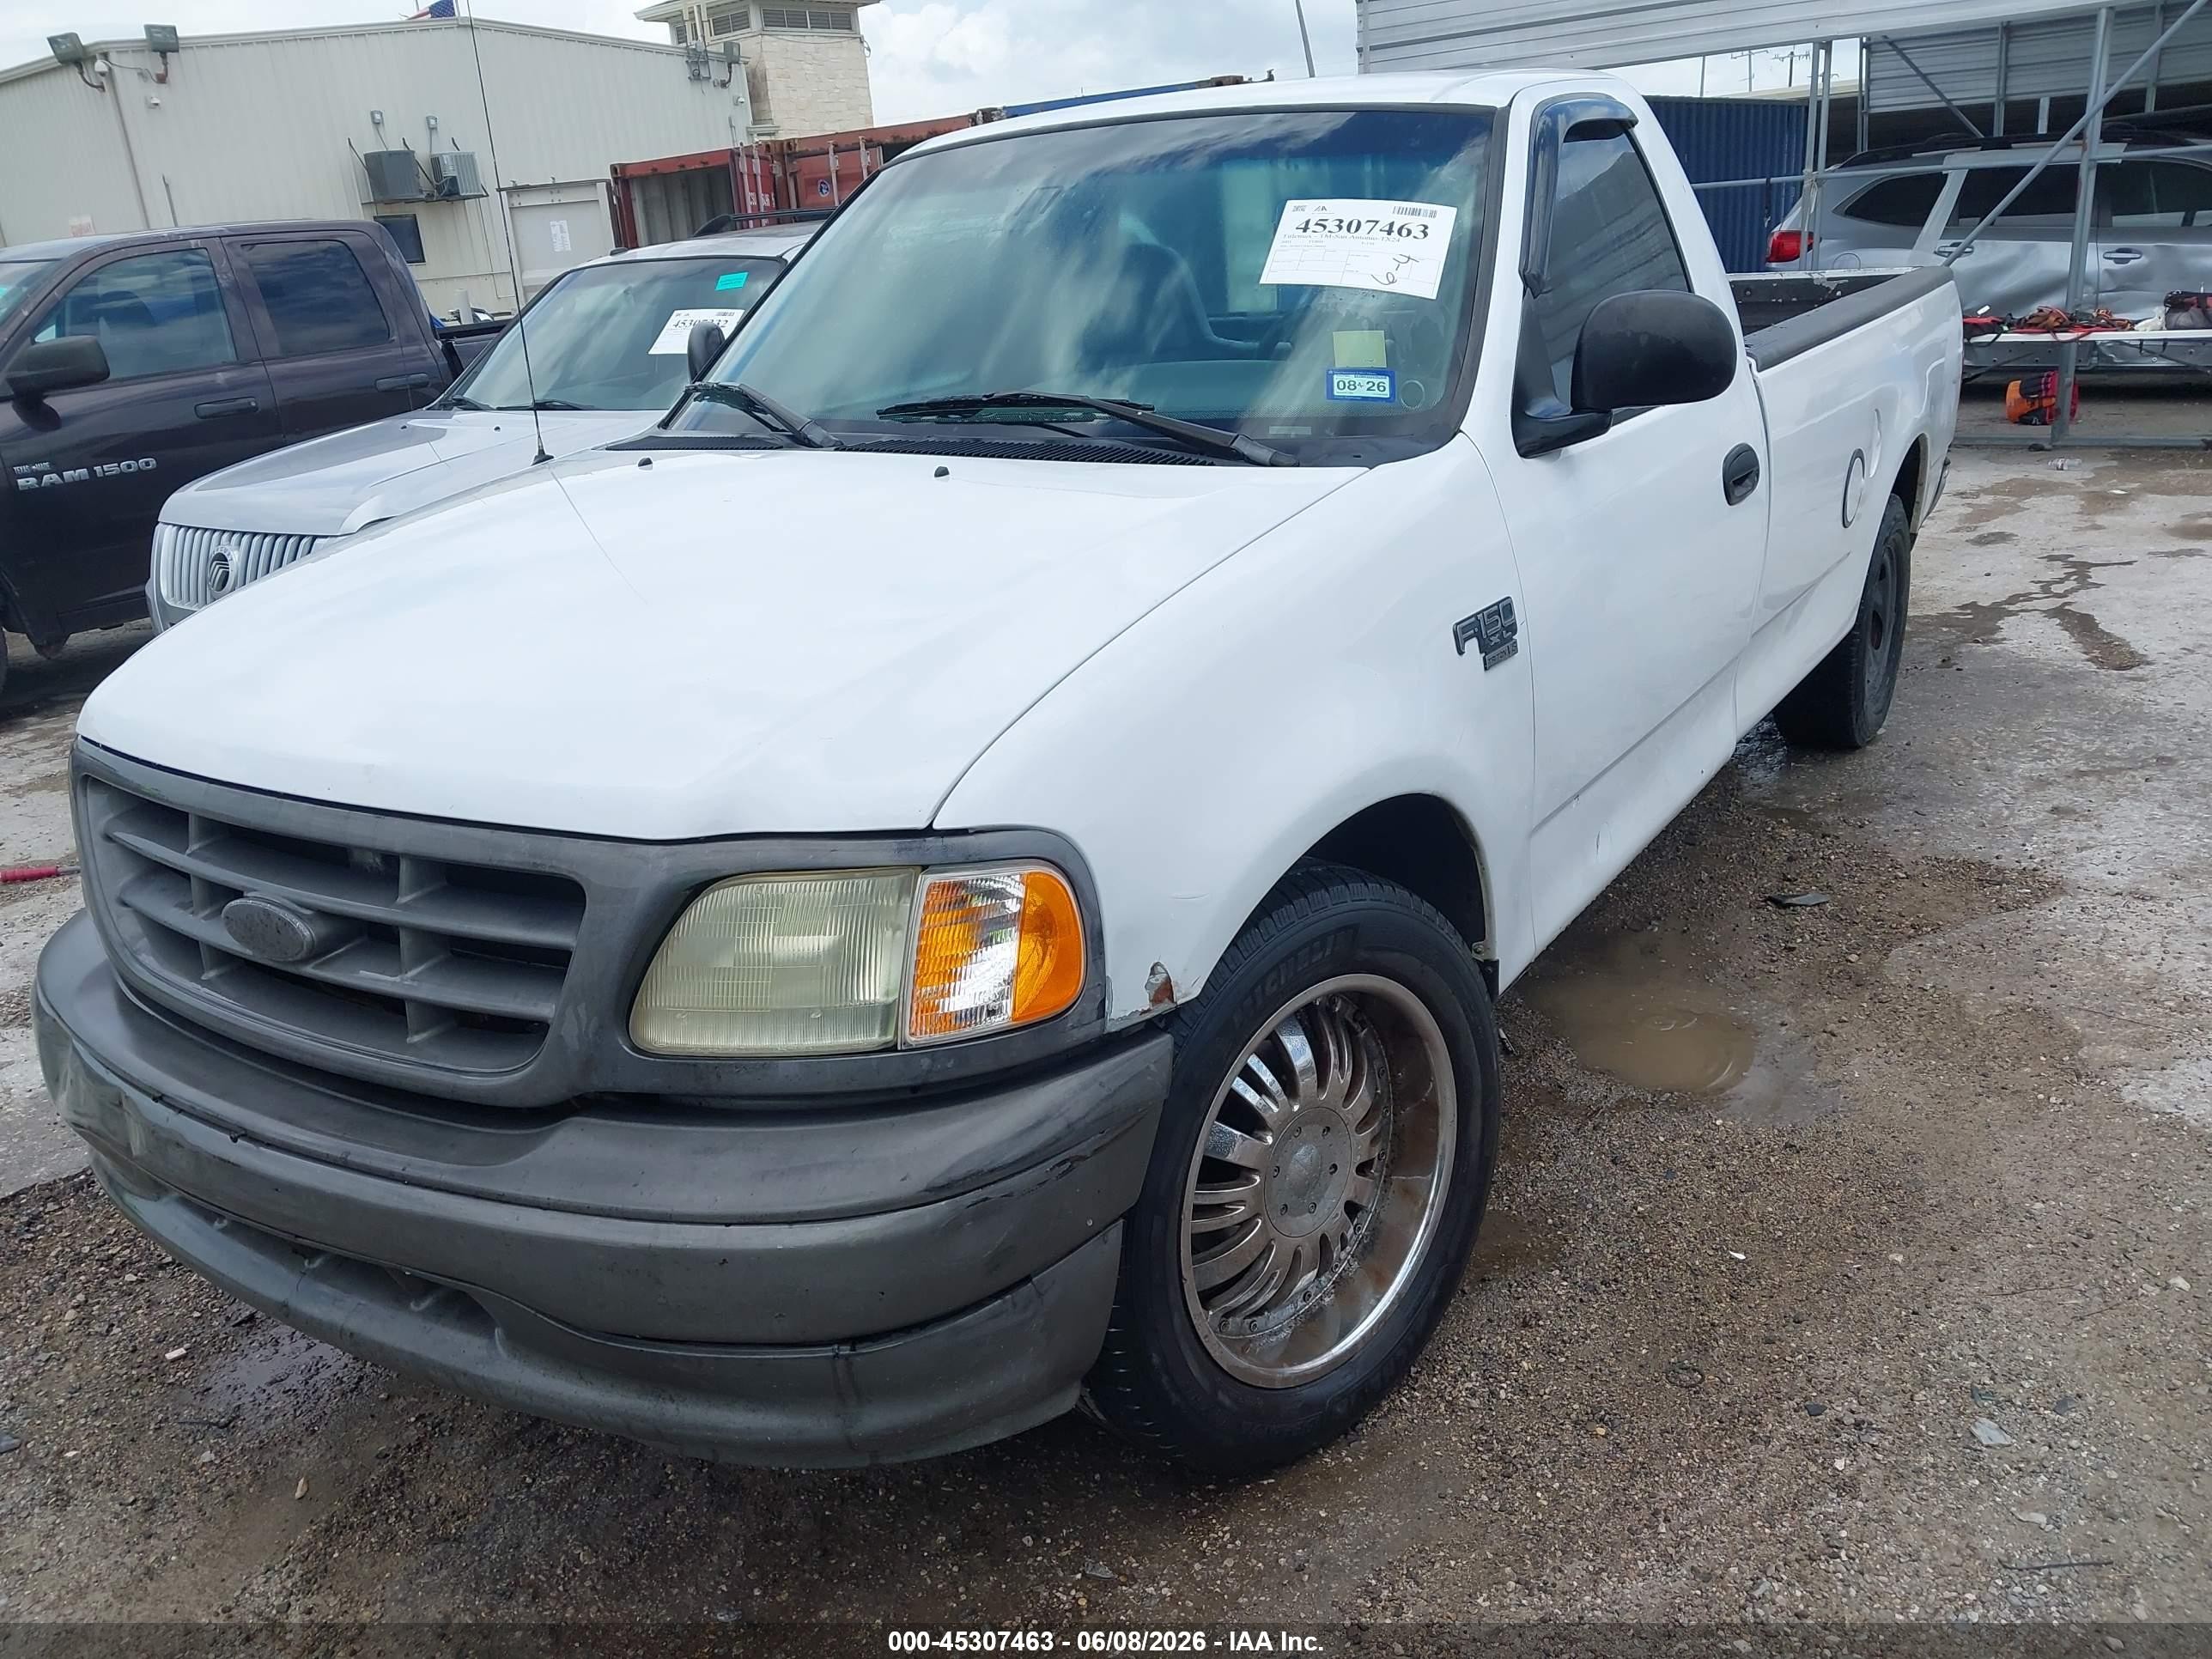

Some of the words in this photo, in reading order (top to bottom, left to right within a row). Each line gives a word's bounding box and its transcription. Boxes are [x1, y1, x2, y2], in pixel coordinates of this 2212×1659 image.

[1295, 218, 1429, 240] 45307463
[17, 468, 89, 490] RAM
[94, 458, 157, 477] 1500
